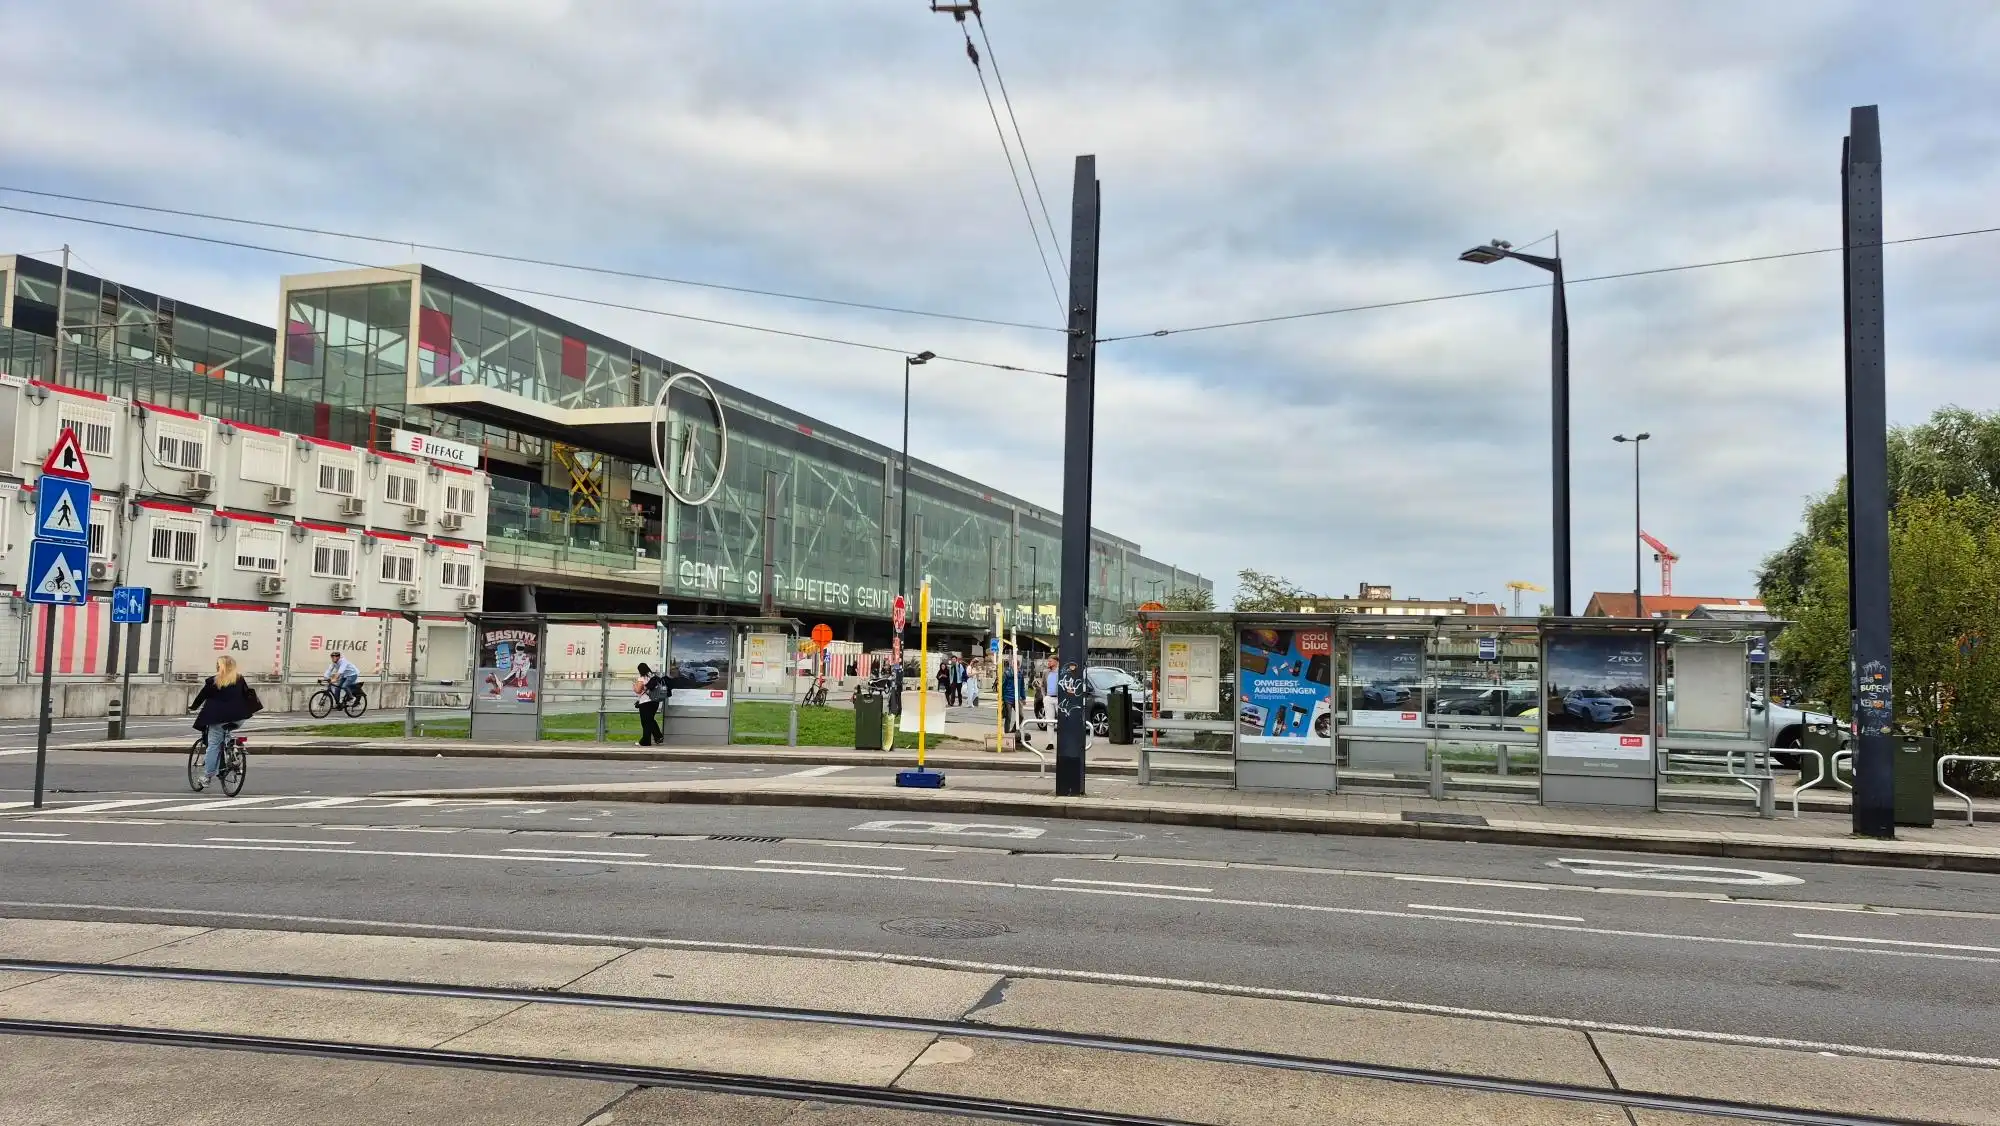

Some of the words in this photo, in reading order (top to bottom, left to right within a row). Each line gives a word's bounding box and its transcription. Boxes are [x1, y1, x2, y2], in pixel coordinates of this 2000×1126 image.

[425, 443, 465, 461] EIFFAGE
[679, 560, 730, 591] GENT
[747, 570, 783, 597] SIT
[794, 577, 850, 605] PIETERS
[857, 586, 889, 609] GENT
[1302, 632, 1328, 641] cool
[231, 639, 249, 651] AB
[325, 640, 368, 651] EIFFAGE
[1302, 641, 1328, 650] blue
[575, 647, 586, 656] AB
[1607, 655, 1643, 663] ZR-V
[1254, 687, 1316, 695] AANBIEDINGEN
